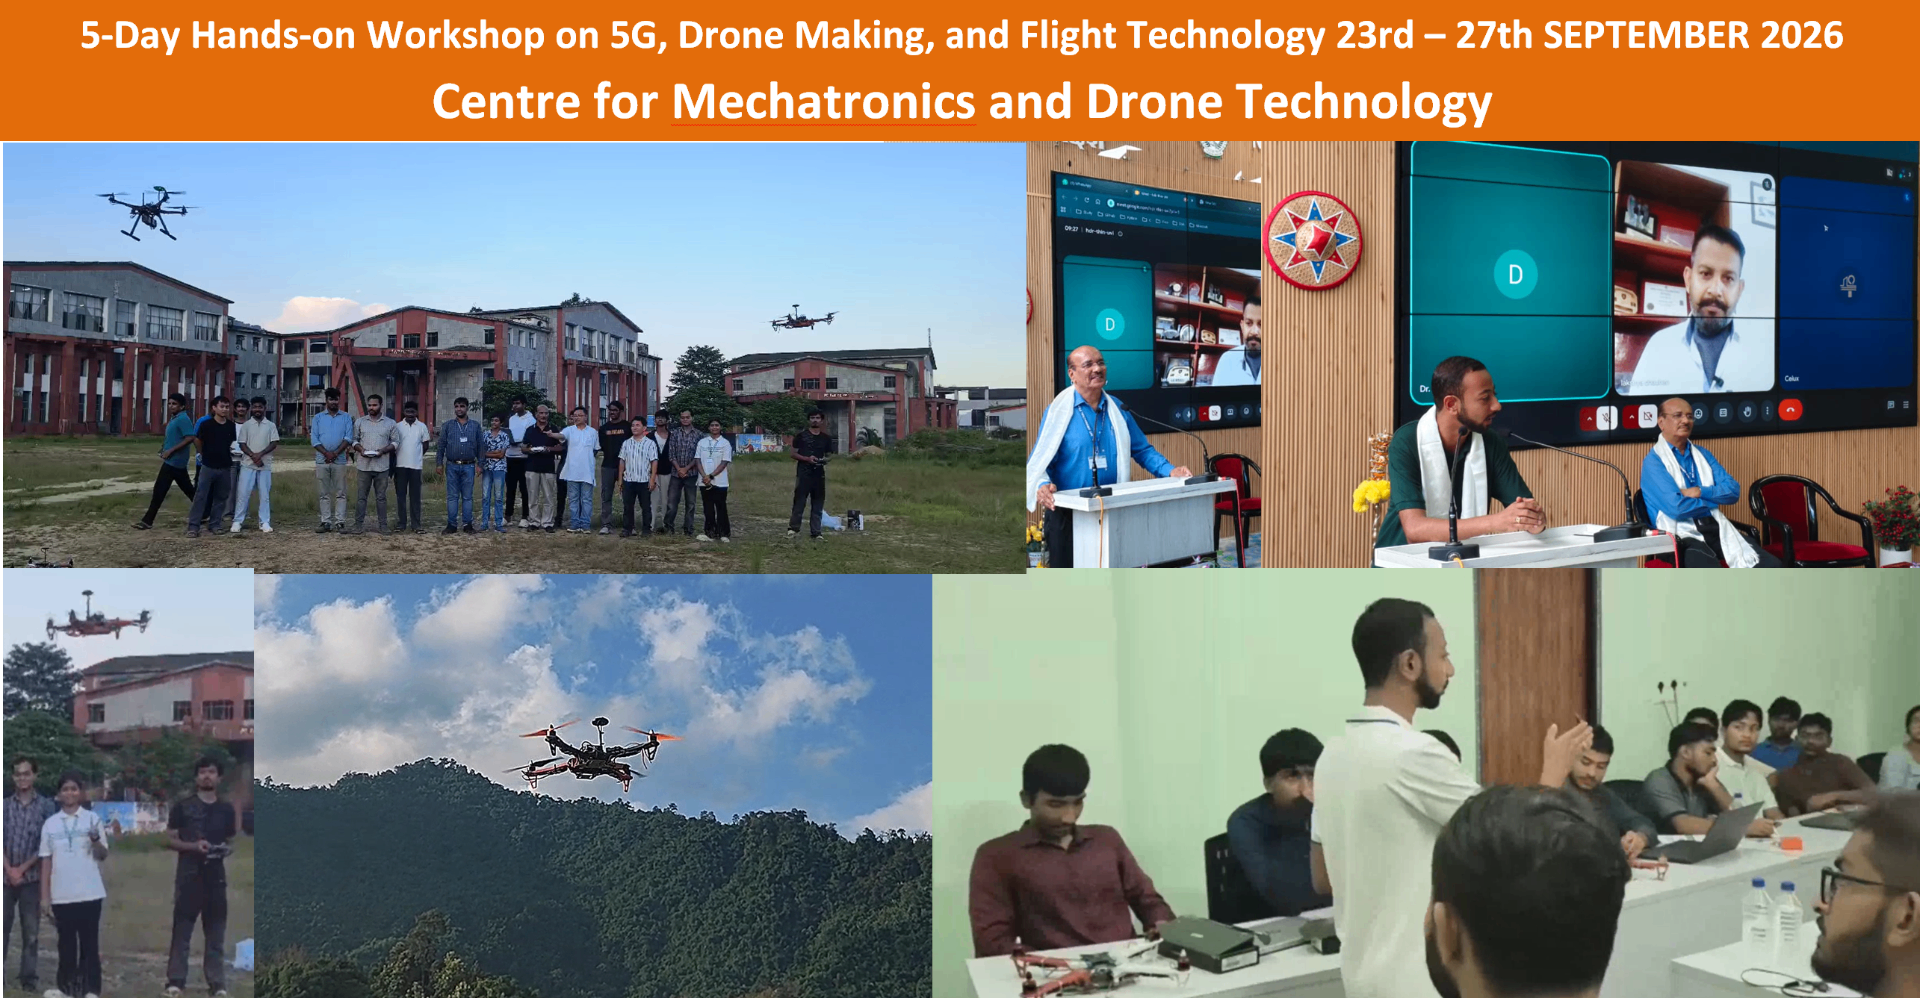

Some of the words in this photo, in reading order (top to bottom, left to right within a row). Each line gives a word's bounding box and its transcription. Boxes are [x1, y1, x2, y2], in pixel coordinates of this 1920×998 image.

[1510, 264, 1523, 284] D
[1106, 317, 1115, 331] D
[1419, 384, 1431, 393] Dr.
